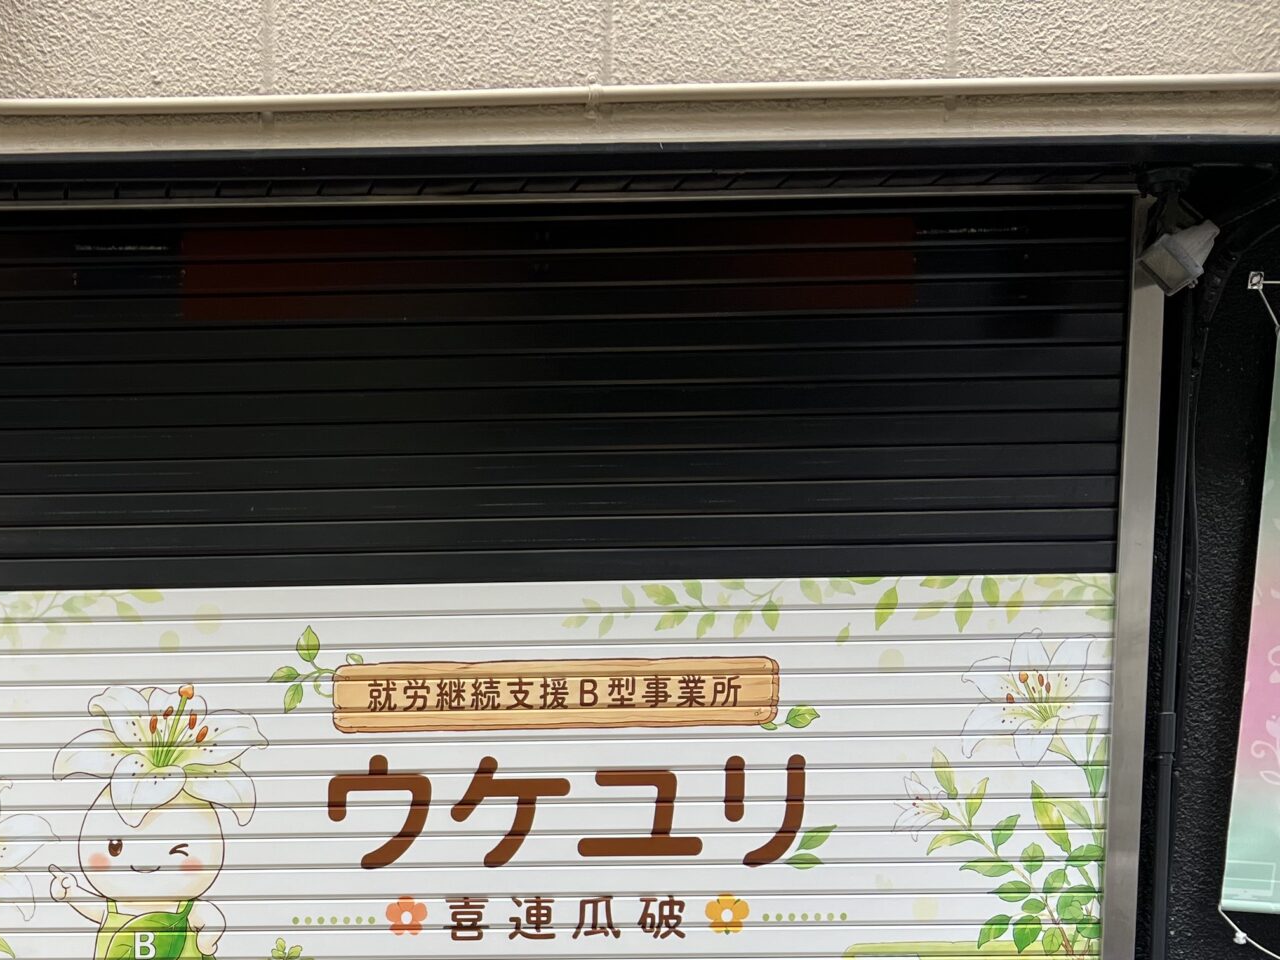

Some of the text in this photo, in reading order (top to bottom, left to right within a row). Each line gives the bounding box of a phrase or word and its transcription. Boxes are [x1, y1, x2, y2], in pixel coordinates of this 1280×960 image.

[367, 675, 743, 713] 就労継続支援B型事業所
[327, 753, 807, 870] ウケユリ
[443, 895, 687, 941] 喜連瓜破
[133, 931, 157, 960] B
